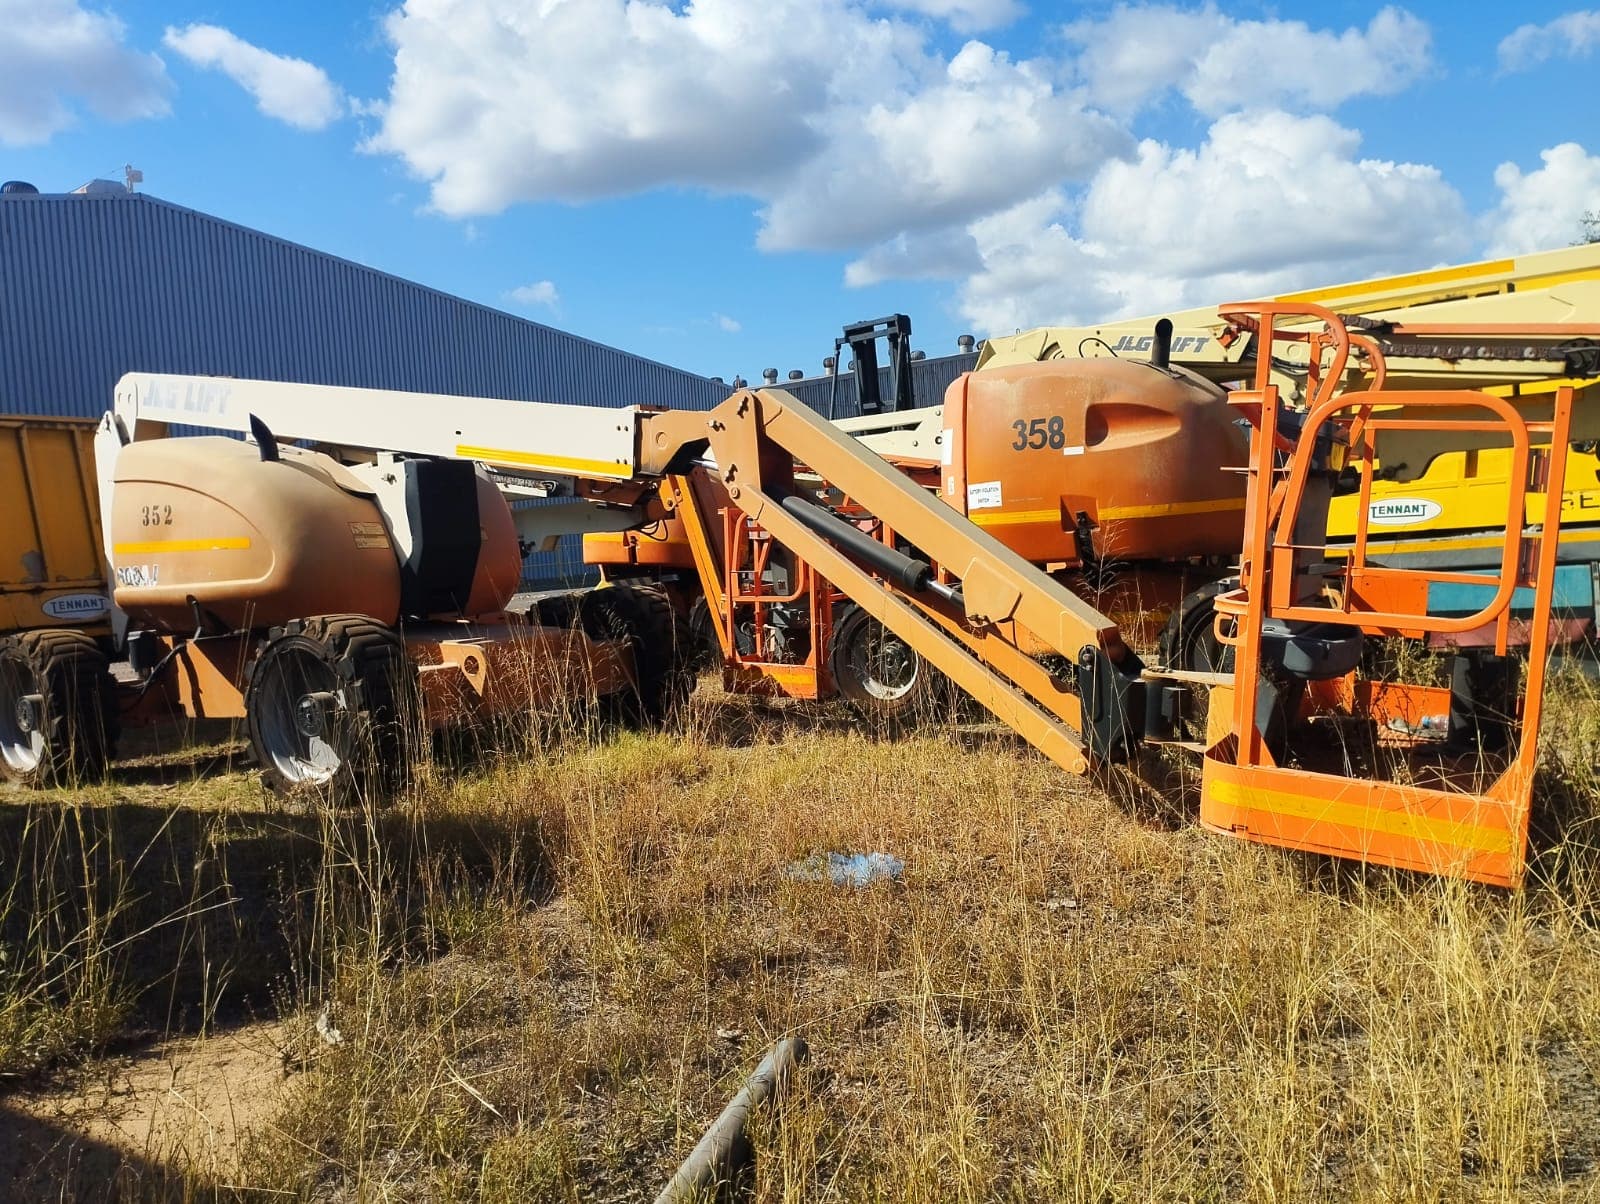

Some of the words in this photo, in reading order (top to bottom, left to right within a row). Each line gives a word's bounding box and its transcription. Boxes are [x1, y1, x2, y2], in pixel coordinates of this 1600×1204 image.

[1112, 336, 1155, 351] JLG
[1170, 336, 1210, 353] IFT
[184, 382, 232, 415] LIFT
[1012, 415, 1066, 451] 358
[142, 504, 173, 527] 352
[1370, 504, 1427, 519] TENNANT
[50, 598, 108, 614] TENNANT
